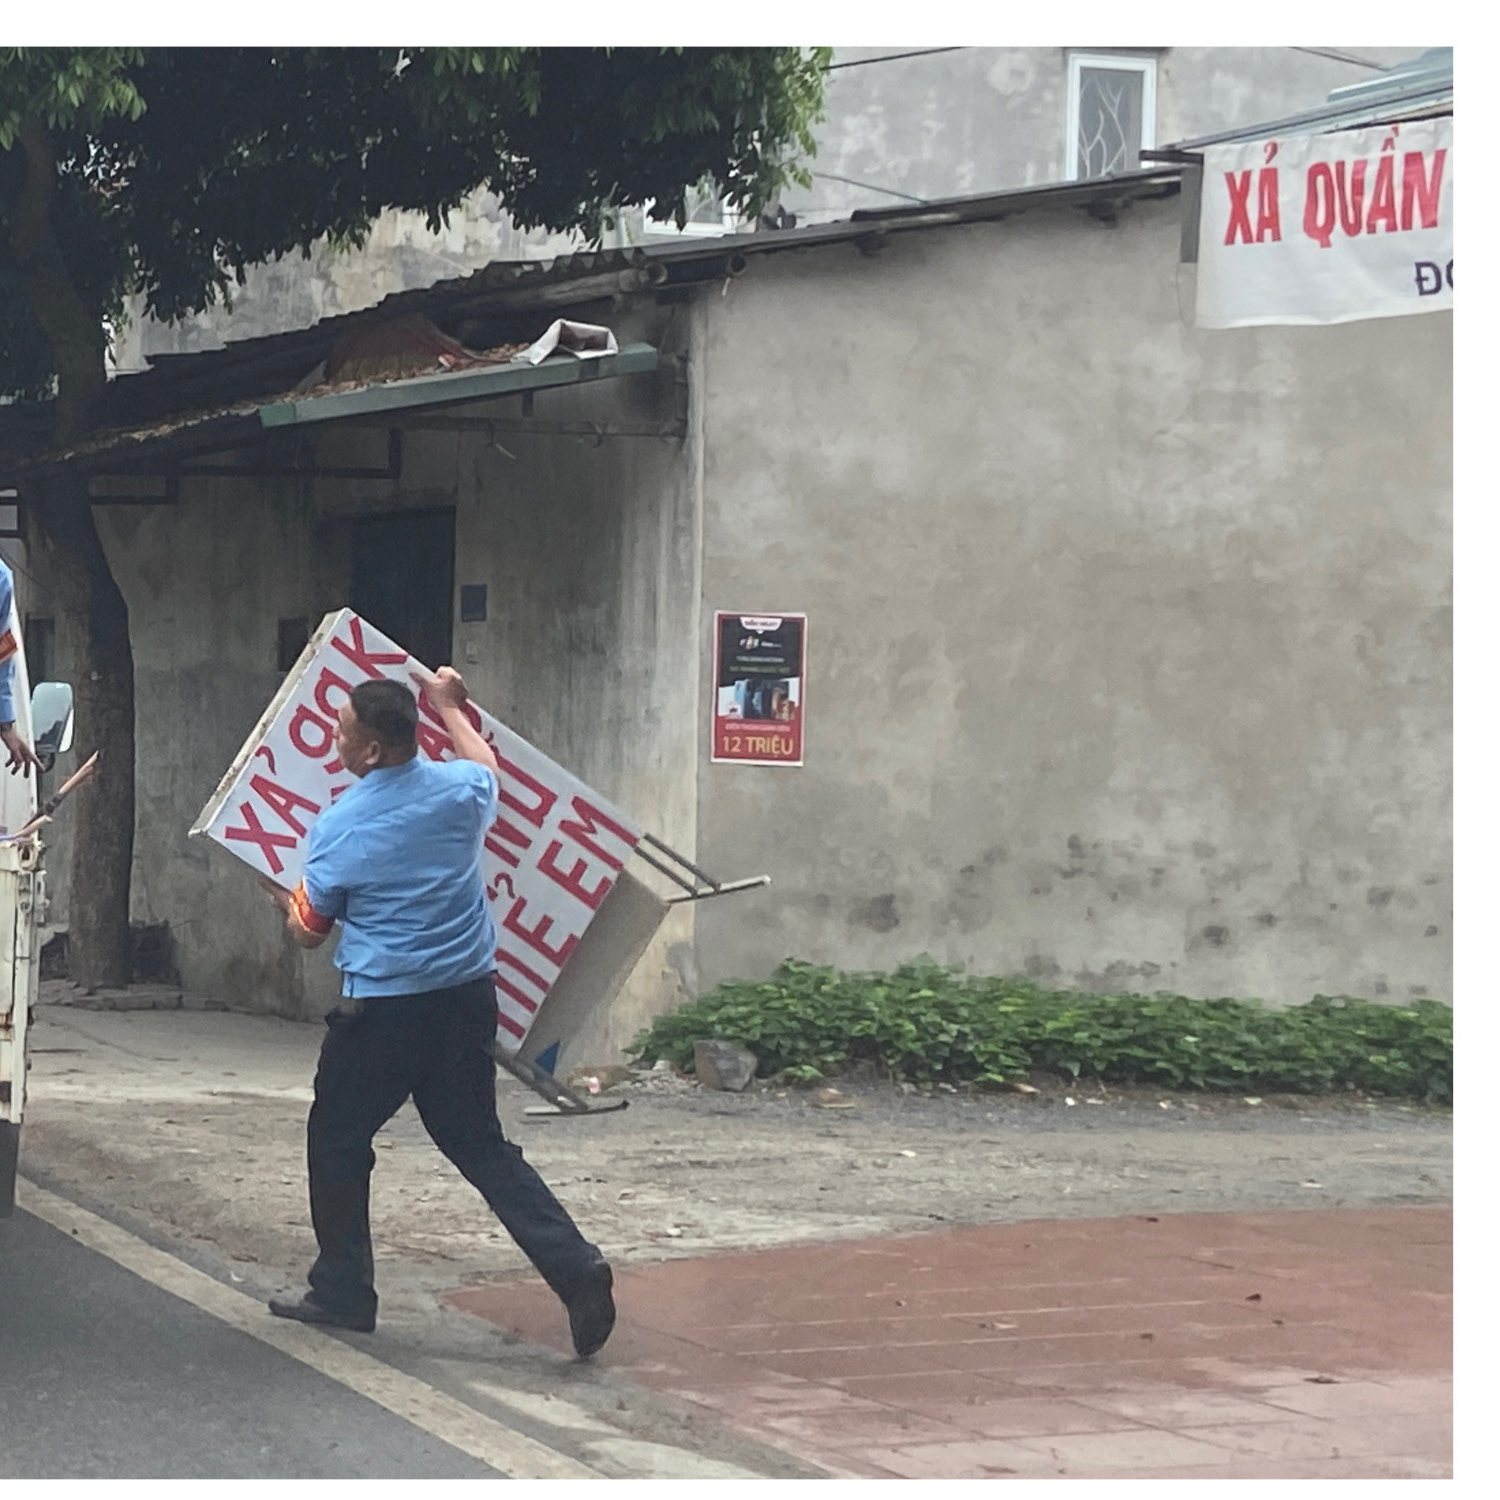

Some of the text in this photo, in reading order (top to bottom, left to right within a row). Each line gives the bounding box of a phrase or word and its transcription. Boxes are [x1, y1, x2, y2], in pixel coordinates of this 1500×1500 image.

[1224, 141, 1282, 246] XẢ
[722, 735, 742, 753] 12
[536, 795, 640, 912] EM
